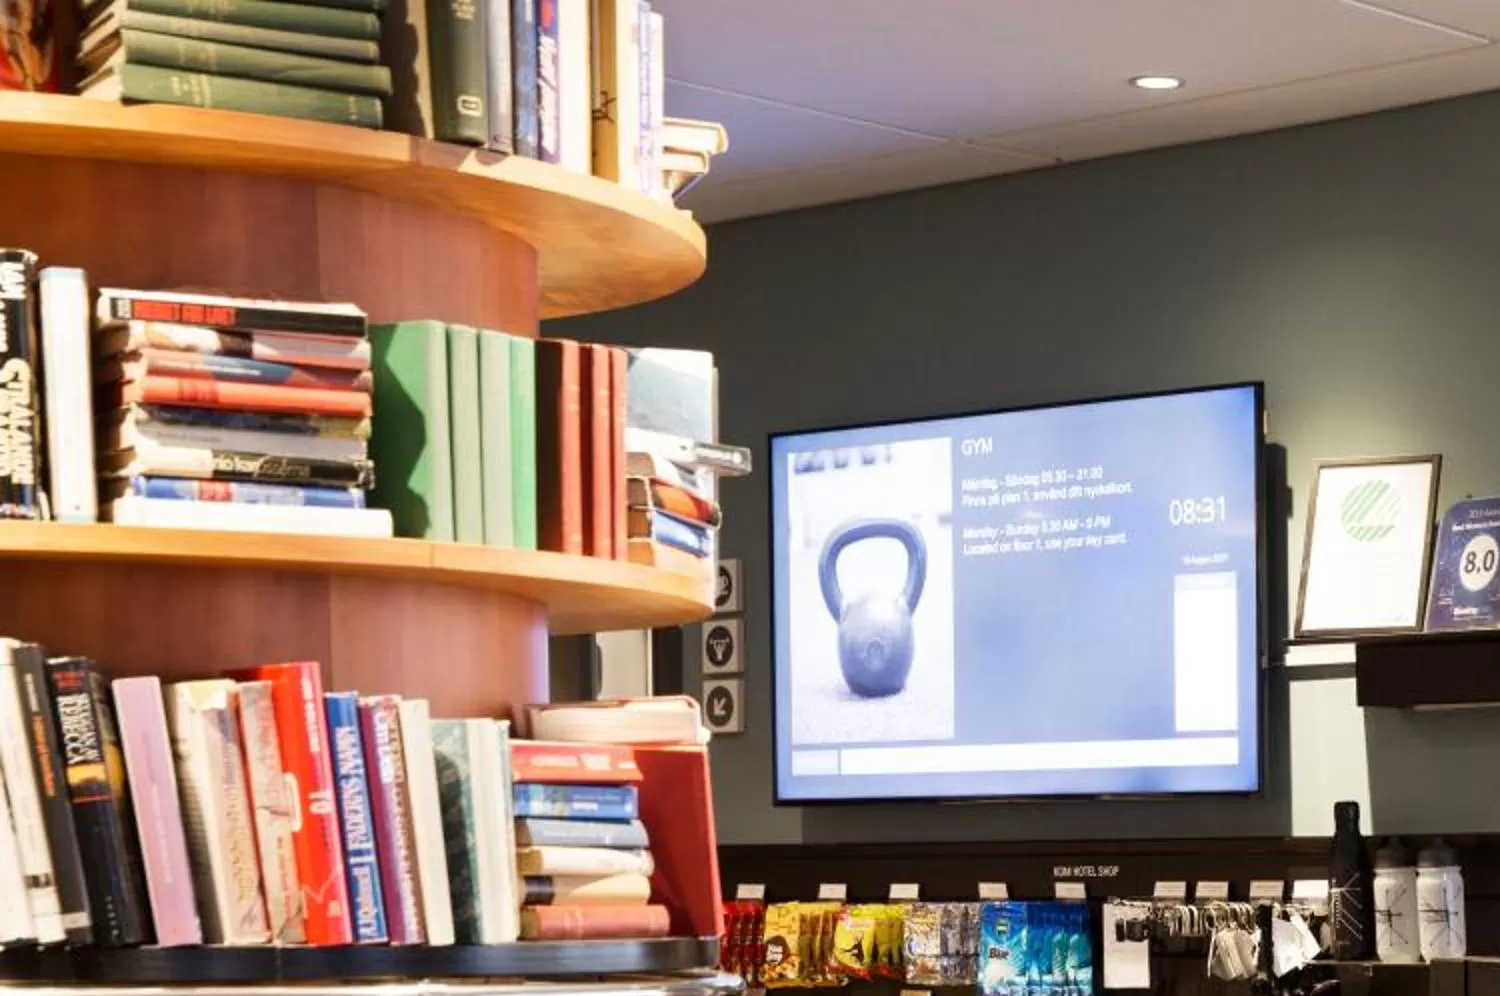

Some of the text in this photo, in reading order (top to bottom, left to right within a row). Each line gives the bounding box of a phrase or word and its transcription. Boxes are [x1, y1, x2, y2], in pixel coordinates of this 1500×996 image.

[961, 436, 993, 456] GYM
[1169, 496, 1225, 525] 08:31
[1464, 549, 1496, 574] 8.0
